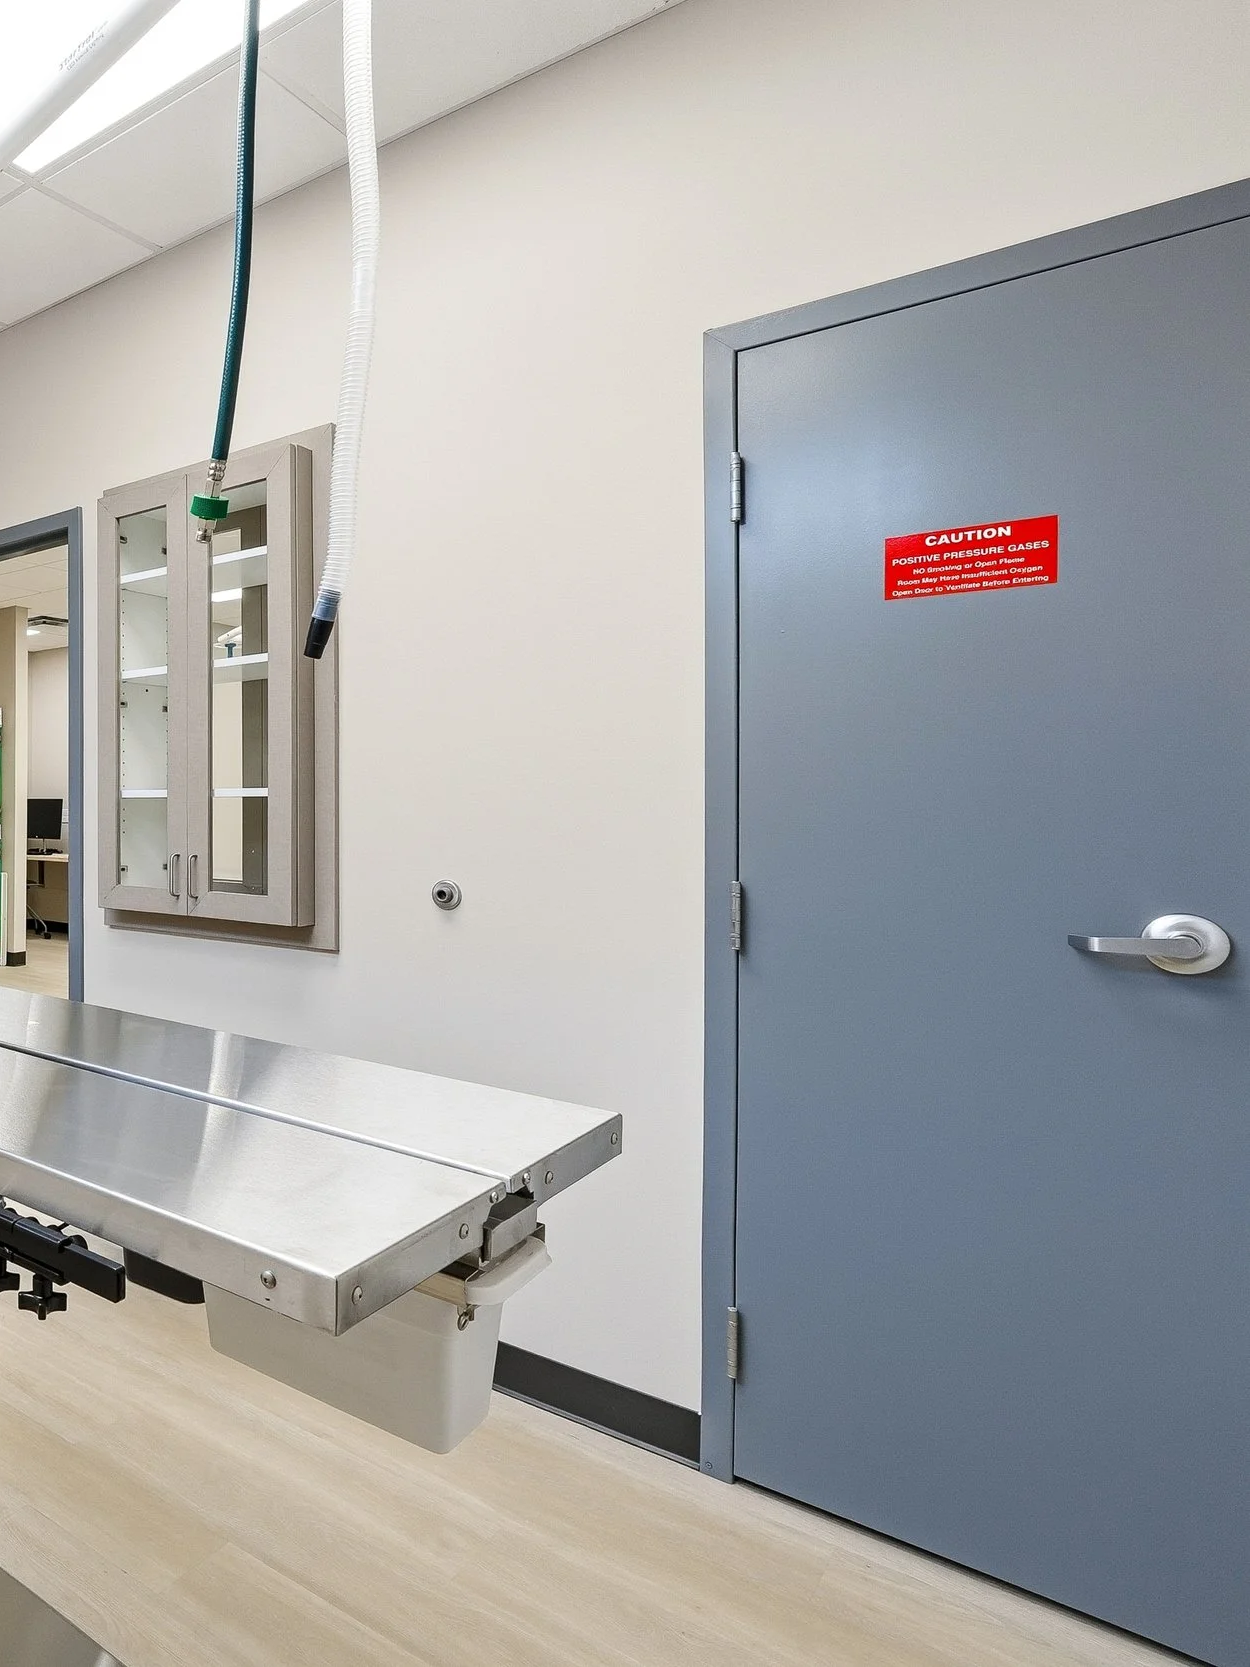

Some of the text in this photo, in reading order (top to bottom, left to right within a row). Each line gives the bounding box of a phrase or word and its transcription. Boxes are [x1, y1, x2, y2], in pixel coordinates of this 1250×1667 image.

[924, 525, 1012, 547] CAUTION
[892, 540, 1050, 567] POSITIVE PRESSURE GASES
[912, 567, 926, 575] NO
[927, 564, 962, 574] Smoking
[974, 560, 997, 568] Open
[921, 576, 938, 584] May
[961, 568, 1008, 579] Insufficient
[1009, 565, 1043, 575] Oxygen
[892, 590, 913, 598] Open
[944, 582, 981, 591] Ventilate
[982, 579, 1010, 587] Before
[1012, 575, 1049, 584] Entering
